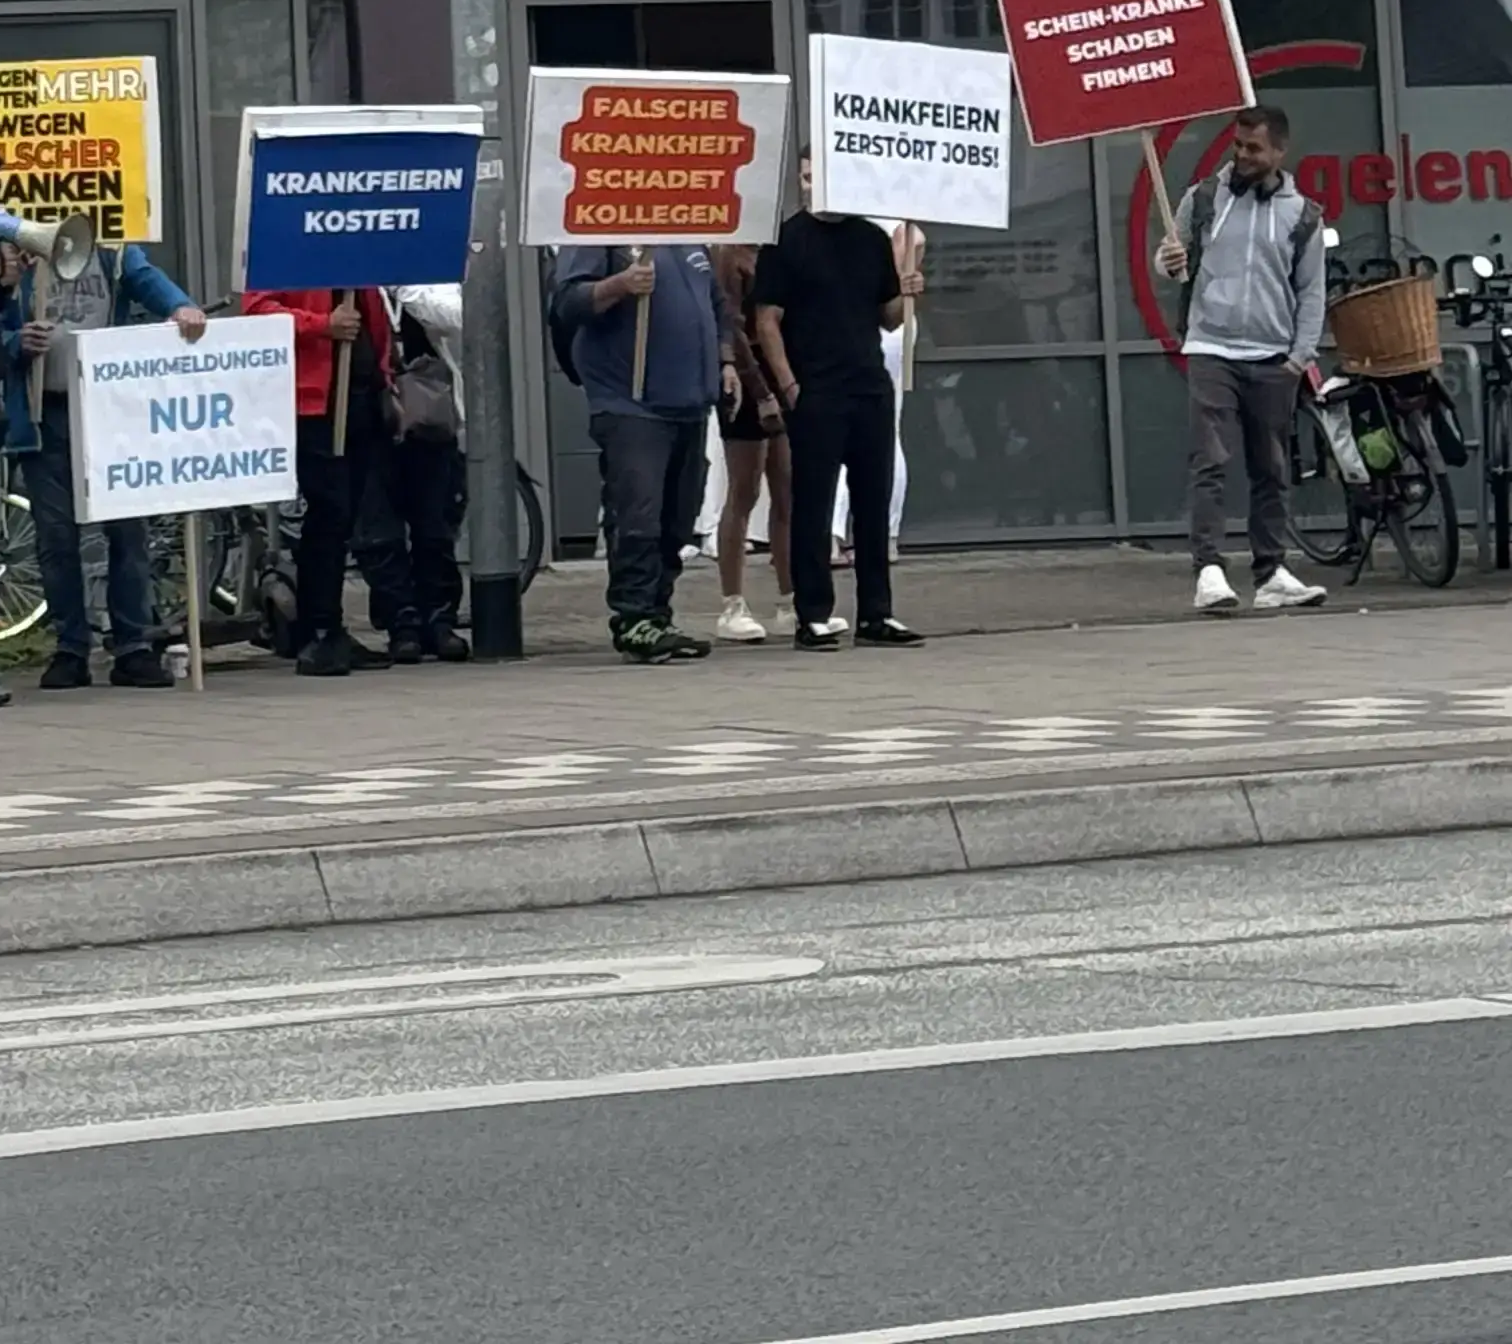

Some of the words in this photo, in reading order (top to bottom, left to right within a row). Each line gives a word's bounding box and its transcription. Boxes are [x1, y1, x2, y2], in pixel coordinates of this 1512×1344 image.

[1066, 27, 1175, 63] SCHADEN
[38, 67, 142, 103] MEHR
[1081, 58, 1175, 92] FIRMEN!
[593, 97, 729, 120] FALSCHE
[834, 92, 1001, 134] KRANKFEIERN
[570, 132, 746, 155] KRANKHEIT
[834, 131, 937, 162] ZERSTÖRT
[941, 142, 1000, 169] JOBS!
[265, 167, 464, 196] KRANKFEIERN
[584, 169, 725, 190] SCHADET
[304, 208, 420, 234] KOSTET!
[574, 204, 729, 225] KOLLEGEN
[92, 347, 288, 382] KRANKMELDUNGEN
[150, 392, 234, 434] NUR
[107, 456, 164, 491] FÜR
[171, 447, 288, 484] KRANKE
